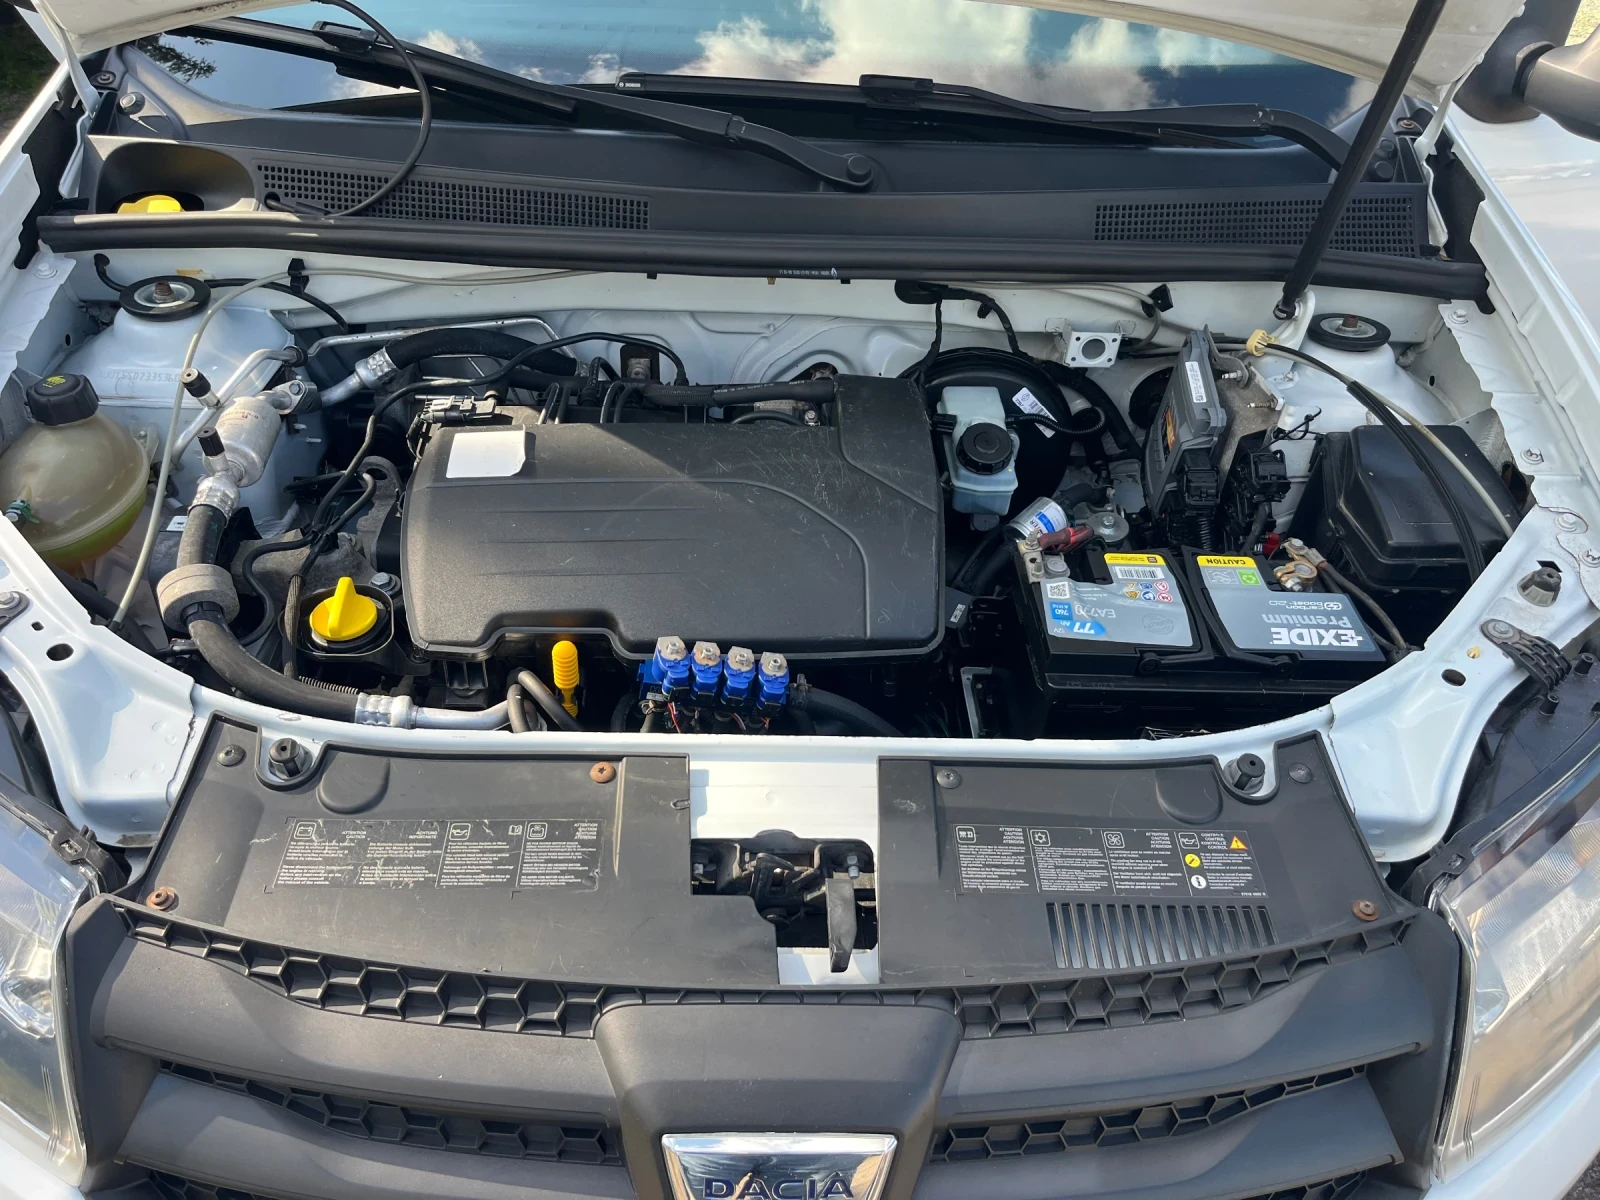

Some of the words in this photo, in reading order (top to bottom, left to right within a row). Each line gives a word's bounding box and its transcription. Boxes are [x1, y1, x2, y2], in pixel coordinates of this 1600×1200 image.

[1074, 604, 1116, 618] EA770
[1073, 622, 1095, 634] 77
[1261, 614, 1353, 628] Premium
[1269, 627, 1363, 647] EXIDE
[703, 1177, 855, 1200] DACIA
